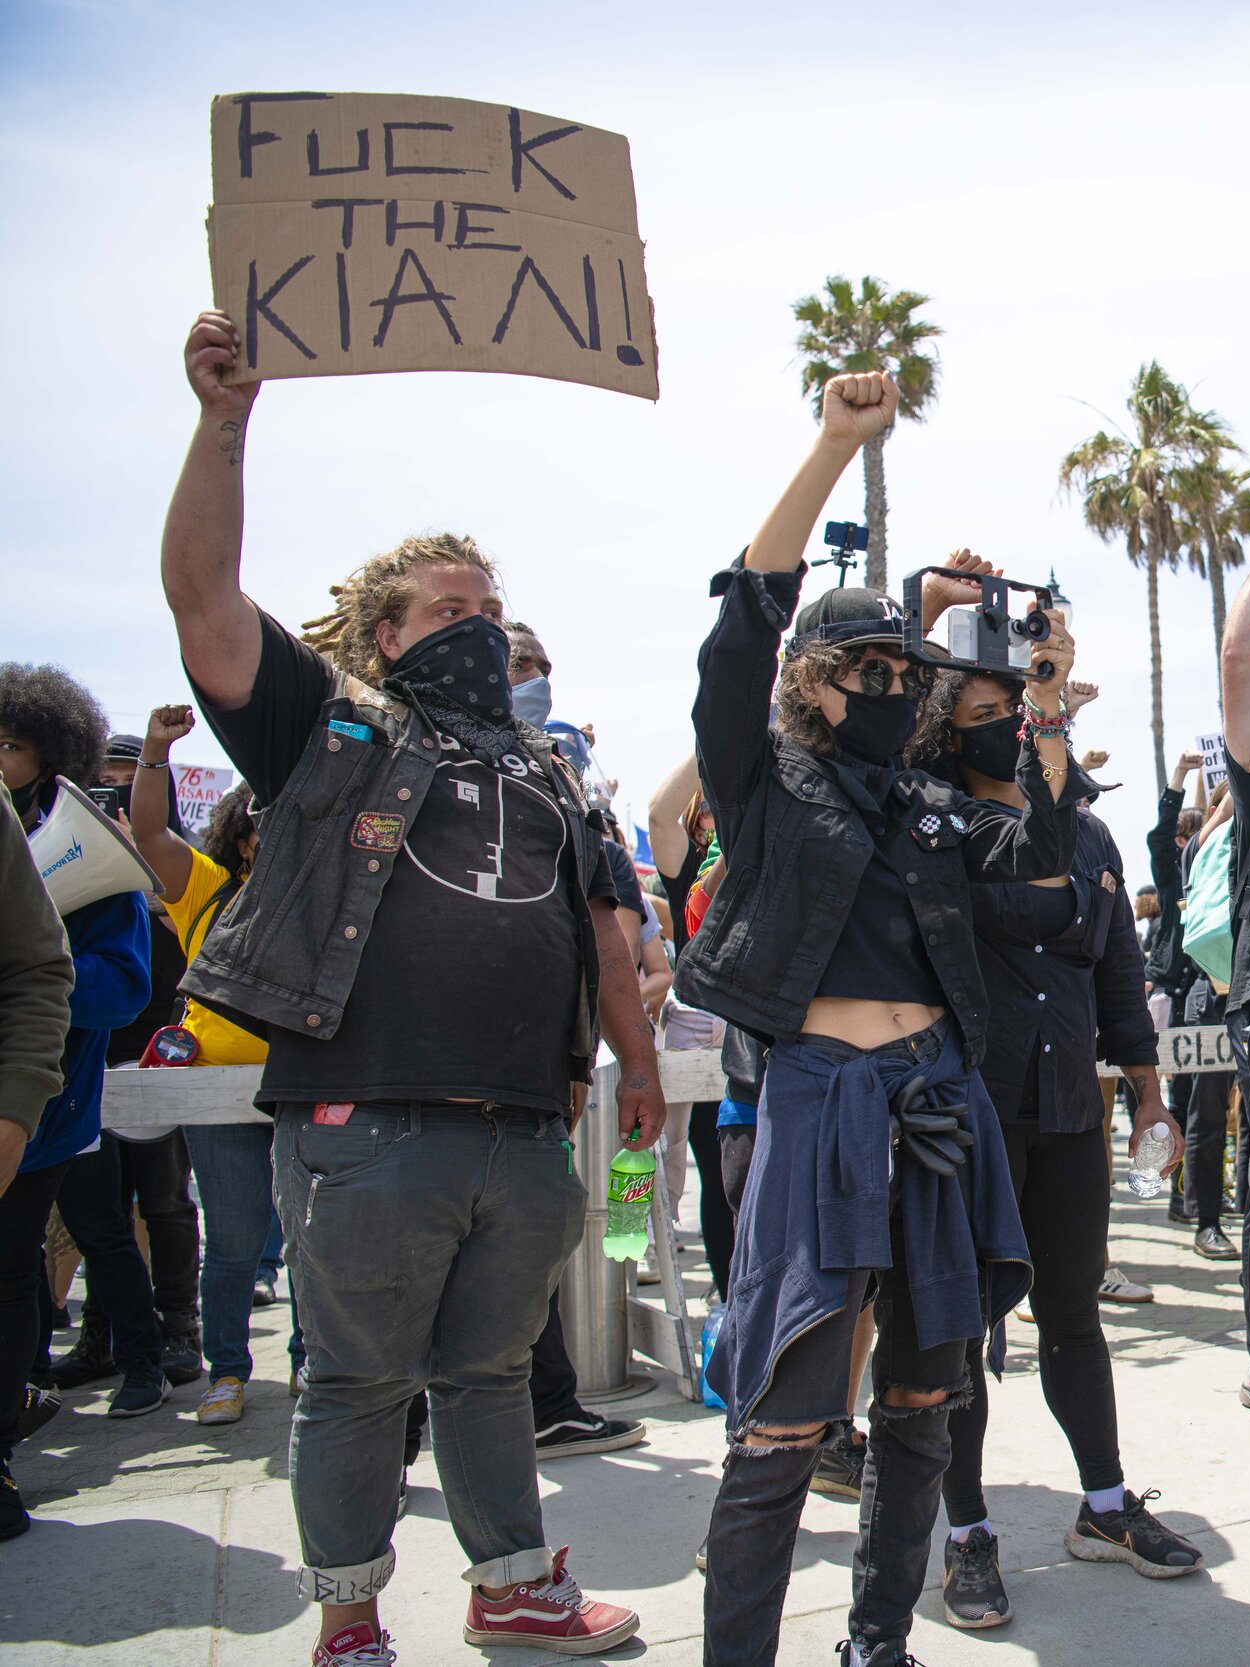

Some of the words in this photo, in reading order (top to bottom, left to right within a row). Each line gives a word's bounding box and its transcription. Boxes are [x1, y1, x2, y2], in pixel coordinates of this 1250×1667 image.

[233, 92, 583, 200] FUCK
[311, 199, 522, 251] THE
[244, 248, 645, 369] KIAN!
[1201, 737, 1215, 751] In
[1205, 752, 1218, 767] of
[332, 1633, 354, 1649] VANS
